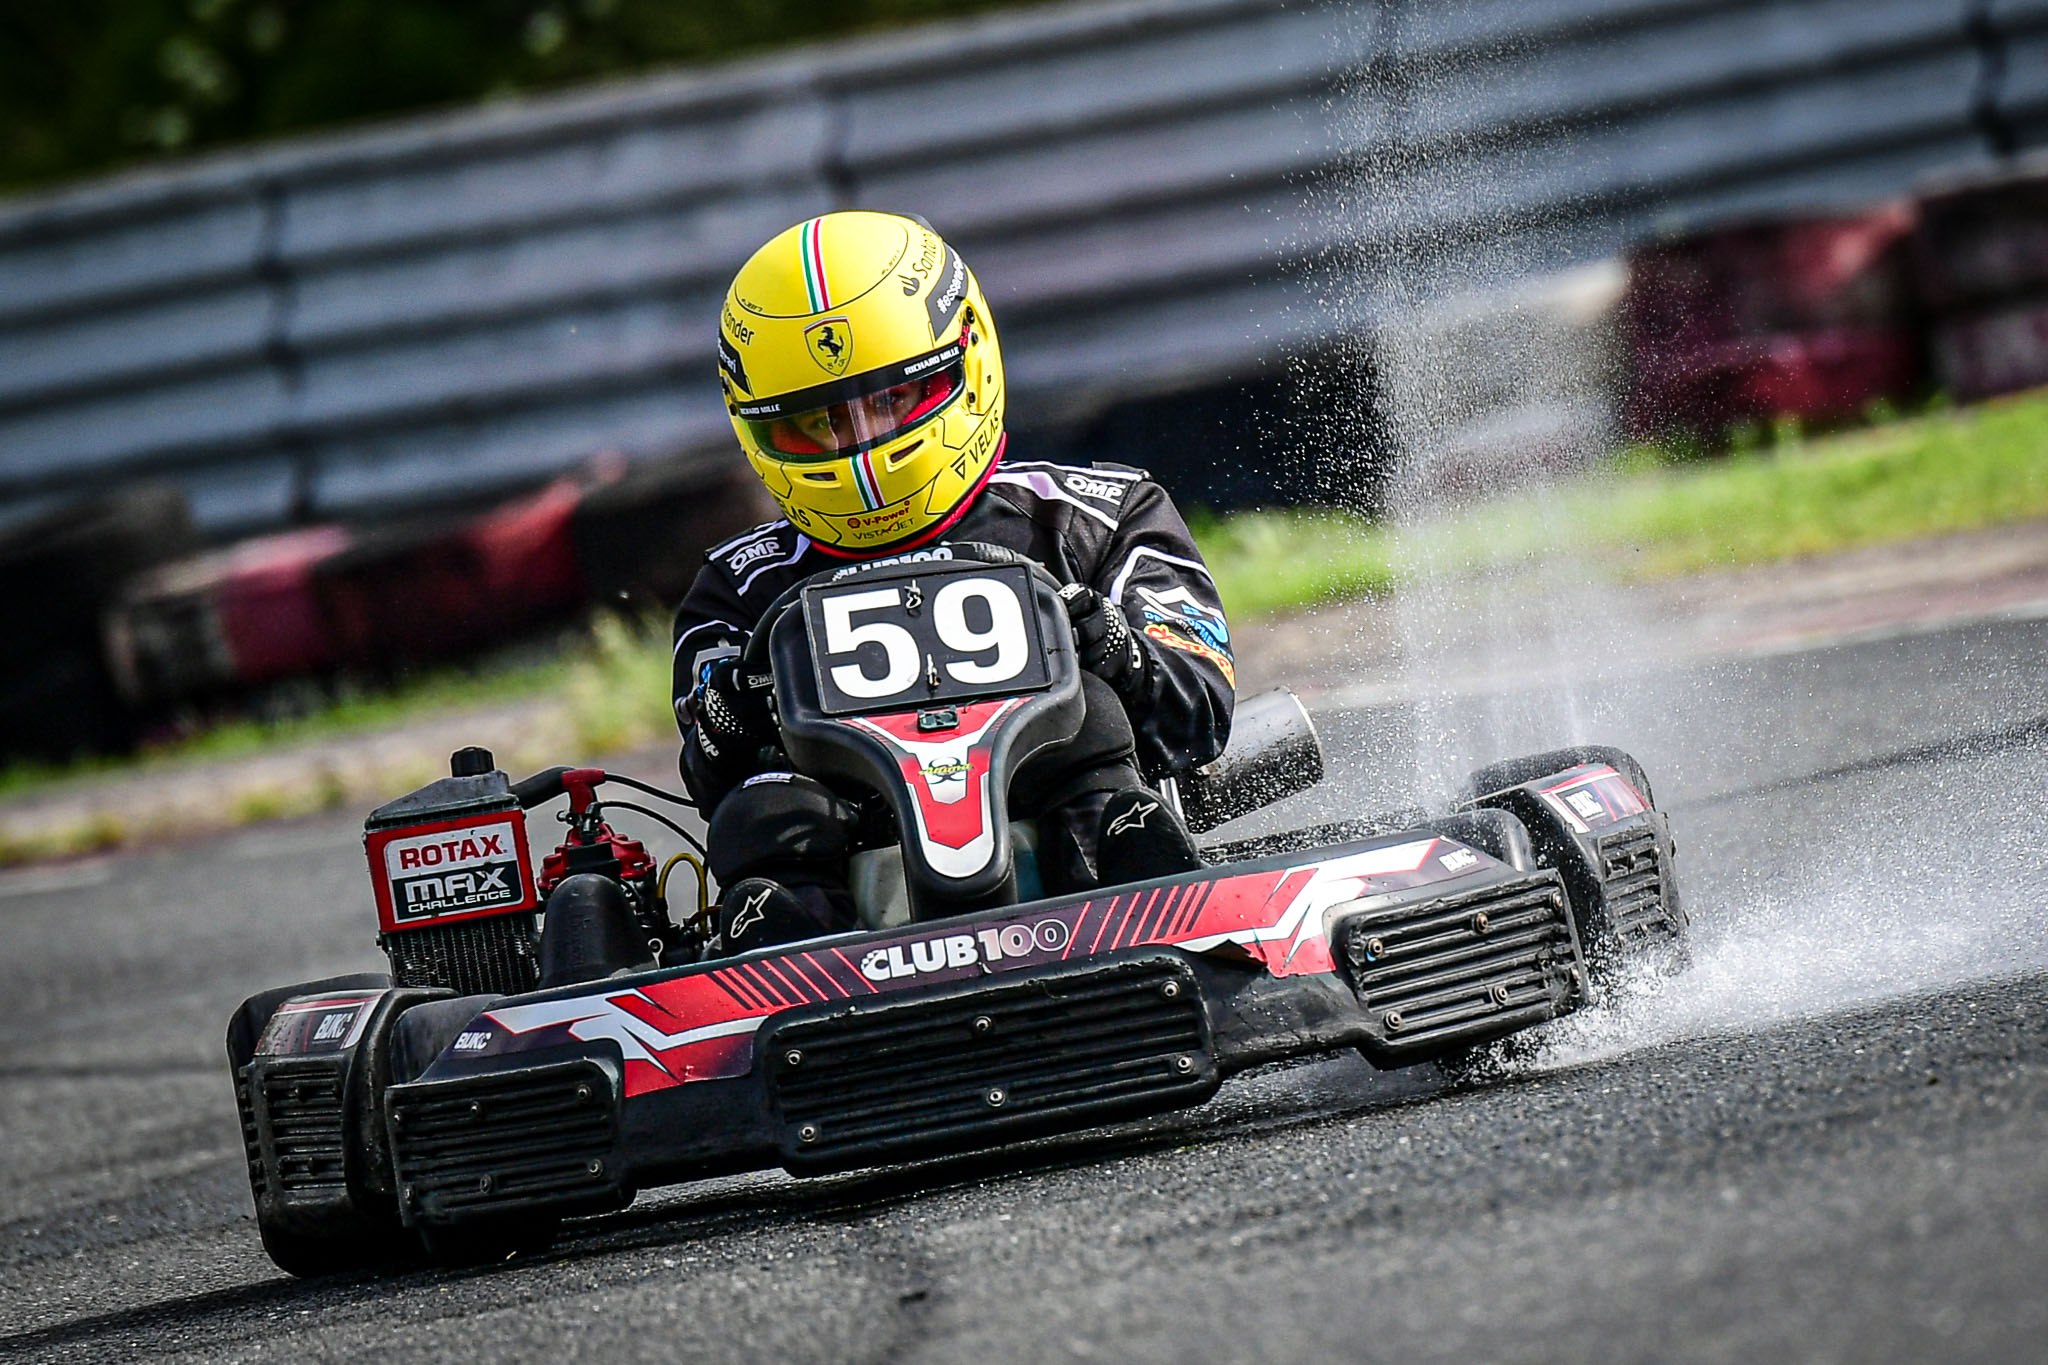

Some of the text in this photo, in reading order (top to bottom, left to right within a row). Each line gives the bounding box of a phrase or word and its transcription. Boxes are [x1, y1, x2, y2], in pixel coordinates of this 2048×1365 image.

[904, 346, 960, 376] RICHARD MILLE
[1066, 475, 1123, 499] OMP
[862, 506, 910, 526] V-Power
[730, 540, 780, 570] OMP
[822, 577, 1029, 698] 59
[400, 834, 503, 870] ROTAX
[408, 889, 512, 913] CHALLENGE
[860, 918, 1070, 981] CLUB100
[313, 1012, 354, 1041] BUKC
[454, 1031, 493, 1051] BUKC
